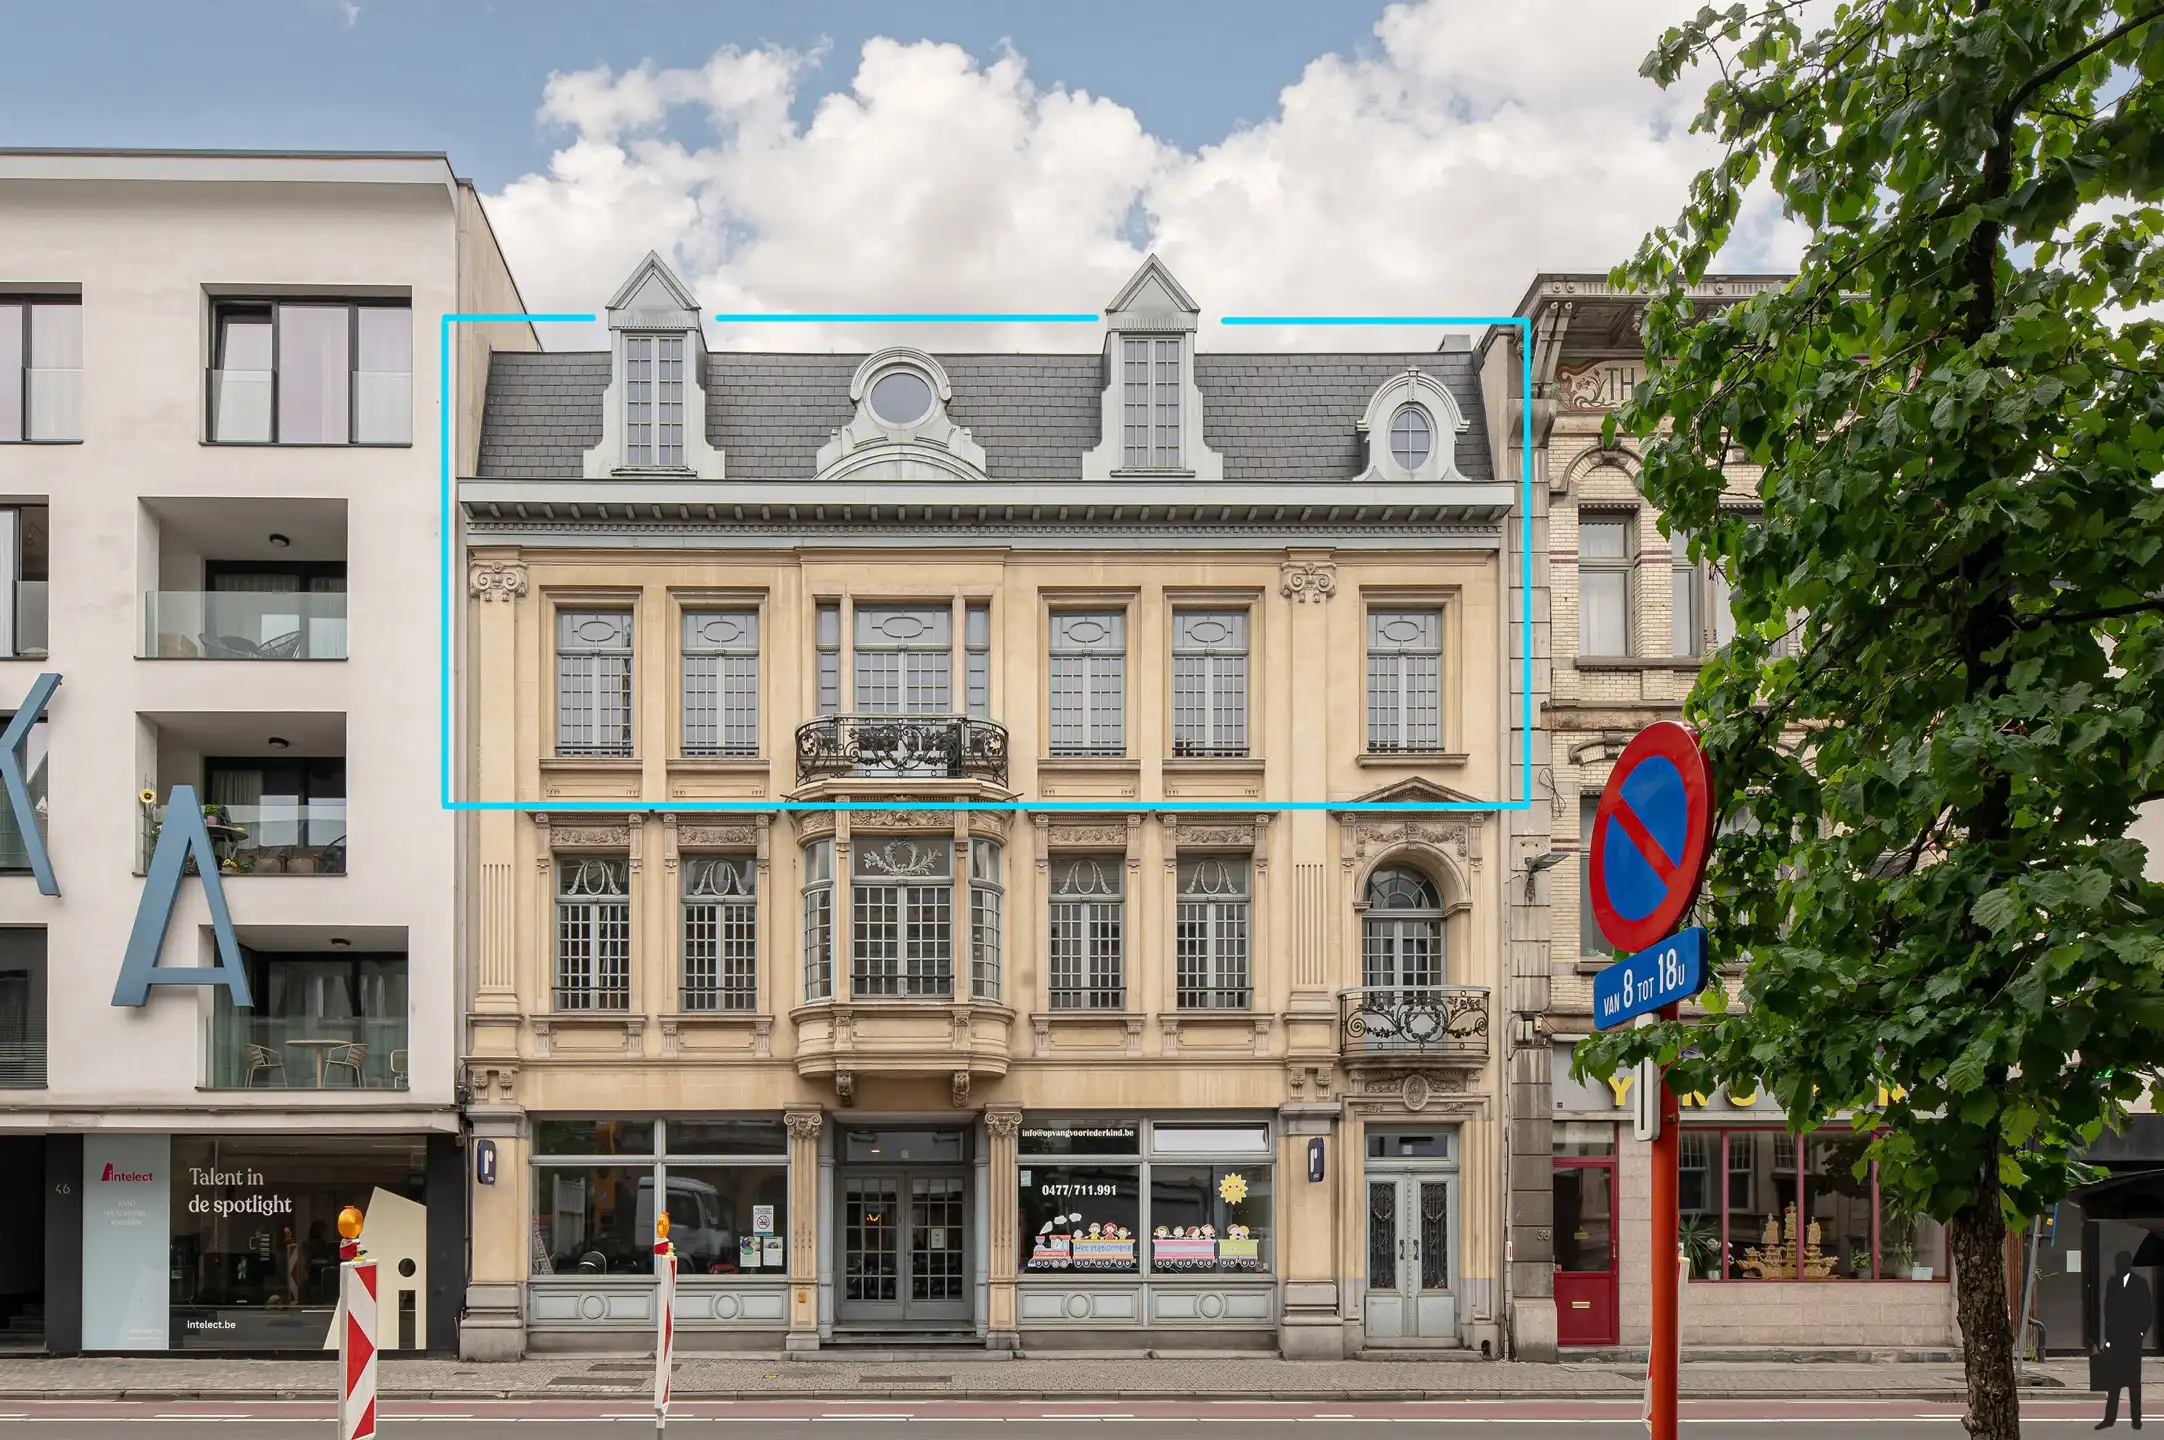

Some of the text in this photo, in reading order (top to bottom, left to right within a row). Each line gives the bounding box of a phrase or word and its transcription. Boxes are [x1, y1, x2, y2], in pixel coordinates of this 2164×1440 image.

[1604, 992, 1620, 1016] VAN
[1623, 968, 1634, 1008] 8
[1637, 977, 1654, 1003] TOT
[1022, 1129, 1134, 1138] info@opvangvooriederkind.be
[189, 1167, 264, 1186] Talent in
[55, 1183, 71, 1195] 46
[1042, 1184, 1117, 1197] 0477/711.991
[188, 1194, 293, 1218] de spotlight
[1075, 1244, 1089, 1252] Het
[187, 1320, 236, 1329] intelect.be
